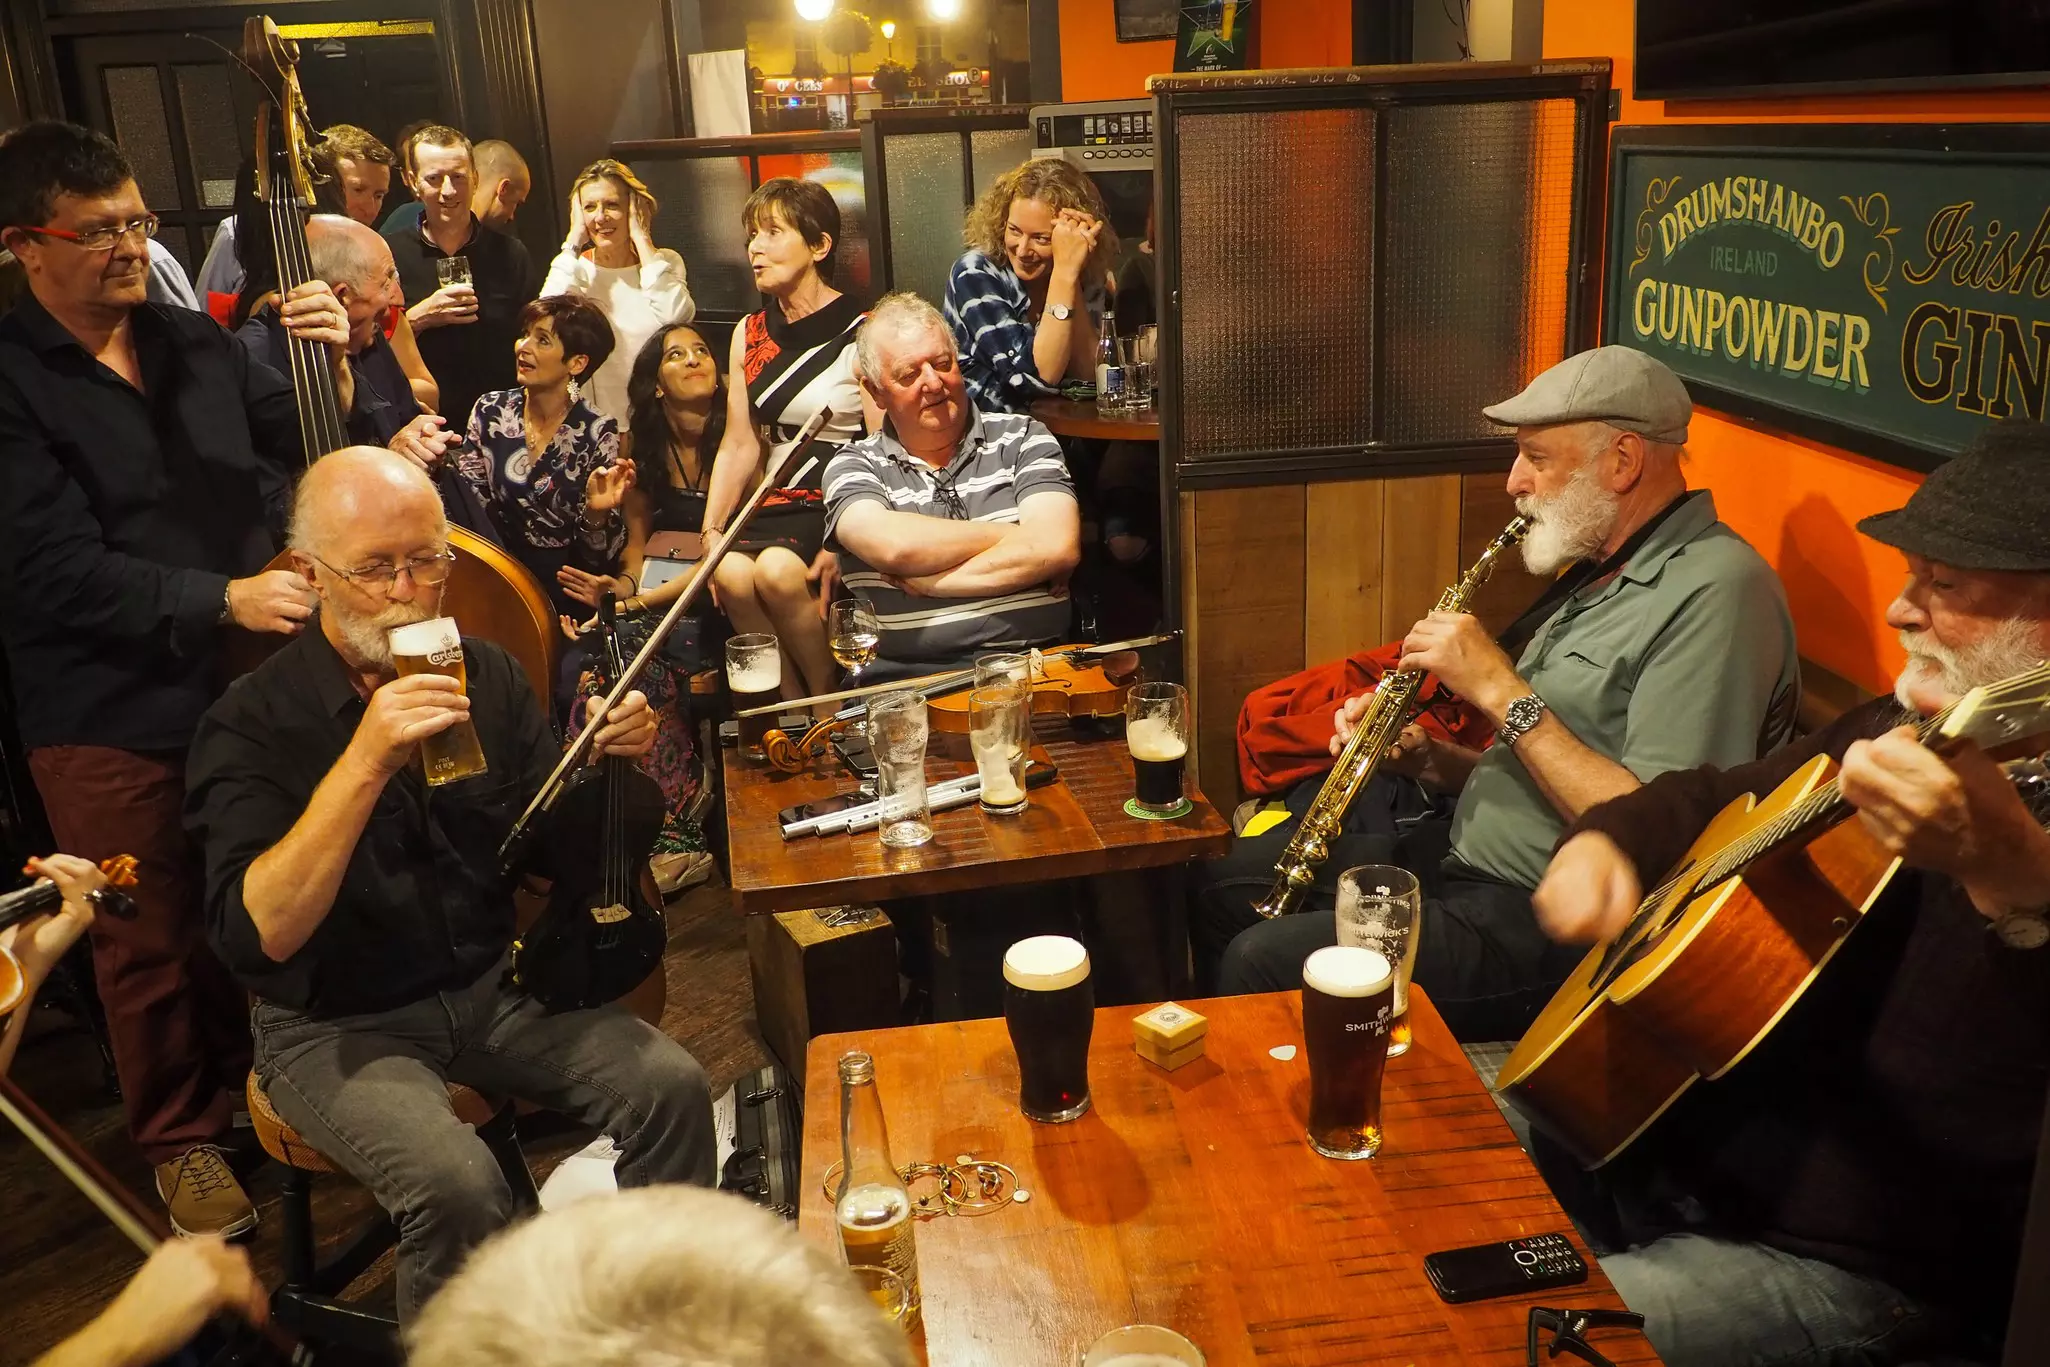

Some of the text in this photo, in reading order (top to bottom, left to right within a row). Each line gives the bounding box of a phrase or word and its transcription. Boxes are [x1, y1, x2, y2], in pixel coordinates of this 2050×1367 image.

[1659, 176, 1845, 269] DRUMSHANBO
[1710, 246, 1778, 277] IRELAND
[1902, 201, 2050, 298] Irish
[1634, 277, 1871, 389] GUNPOWDER
[1901, 302, 2050, 423] GIN
